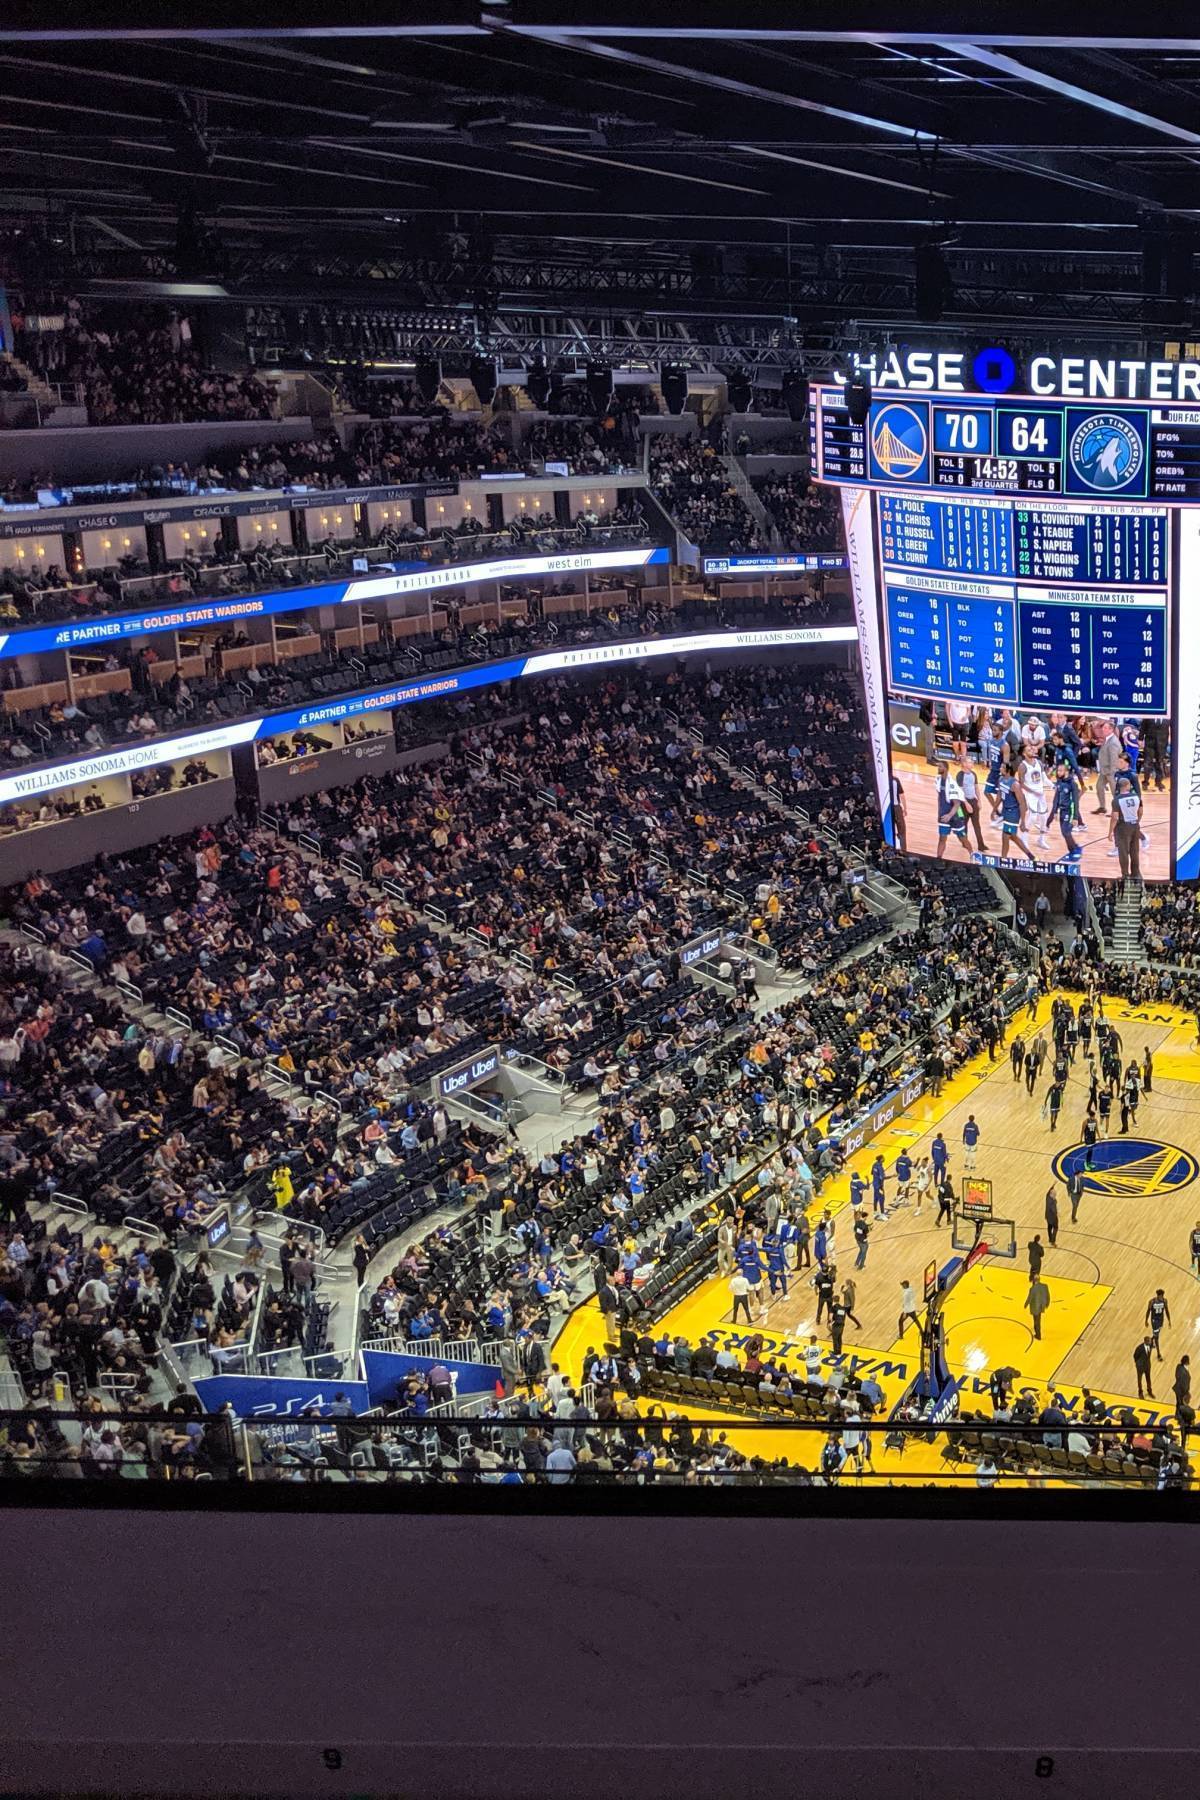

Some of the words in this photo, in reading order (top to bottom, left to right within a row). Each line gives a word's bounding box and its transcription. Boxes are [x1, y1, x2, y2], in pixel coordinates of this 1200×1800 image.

[945, 414, 978, 448] 70
[1012, 417, 1048, 452] 64
[1156, 433, 1180, 442] EFG%
[1075, 419, 1104, 461] MINNESOTA
[1109, 419, 1139, 478] TIMBERWOLVES
[1156, 450, 1174, 459] TO%
[939, 459, 954, 467] TOL
[957, 458, 964, 469] 5
[974, 458, 1018, 480] 14:52
[1028, 464, 1045, 472] TOL
[1048, 463, 1055, 474] 5
[1156, 467, 1184, 476] OREB%
[939, 475, 954, 483] FLS
[957, 474, 964, 485] 0
[971, 480, 983, 488] 3rd
[984, 480, 1019, 490] QUARTER
[1028, 480, 1043, 489] FLS
[1048, 480, 1055, 490] 0
[1166, 484, 1186, 492] RATE
[895, 500, 902, 510] J.
[902, 500, 925, 513] POOLE
[79, 519, 108, 528] CHASE
[895, 513, 904, 523] M.
[905, 514, 931, 527] CHRISS
[1018, 512, 1028, 523] 33
[1033, 513, 1041, 524] R.
[1042, 513, 1085, 526] COVINGTON
[896, 526, 903, 536] D.
[904, 527, 935, 540] RUSSELL
[1021, 525, 1027, 536] 0
[1033, 526, 1041, 537] J.
[1042, 527, 1074, 539] TEAGUE
[897, 538, 904, 549] D.
[904, 539, 928, 551] GREEN
[1019, 538, 1028, 549] 13
[1033, 539, 1041, 550] S.
[1043, 540, 1073, 551] NAPIER
[547, 557, 572, 569] west
[574, 556, 592, 568] elm
[897, 550, 904, 561] S.
[905, 551, 928, 565] CURRY
[1019, 551, 1030, 562] 22
[1034, 552, 1042, 563] A.
[1043, 552, 1079, 565] WIGGINS
[1019, 564, 1030, 575] 32
[1034, 564, 1042, 576] K.
[1044, 565, 1074, 578] TOWNS
[906, 576, 930, 588] GOLDEN
[930, 580, 949, 590] STATE
[950, 582, 968, 593] TEAM
[969, 584, 990, 595] STATS
[1048, 591, 1090, 601] MINNESOTA
[1091, 593, 1111, 602] TEAM
[1112, 594, 1135, 604] STATS
[73, 624, 120, 640] PARTNER
[143, 613, 183, 628] GOLDEN
[186, 609, 213, 622] STATE
[214, 601, 264, 618] WARRIORS
[736, 632, 782, 644] WILLIAMS
[785, 631, 822, 641] SONOMA
[299, 714, 308, 723] E
[309, 705, 346, 722] PARTNER
[364, 692, 395, 709] GOLDEN
[397, 687, 419, 701] STATE
[420, 679, 458, 695] WARRIORS
[891, 723, 921, 746] er
[14, 769, 77, 793] WILLIAMS
[78, 757, 126, 777] SONOMA
[128, 749, 159, 765] HOME
[684, 948, 700, 963] Uber
[703, 938, 719, 953] Uber
[1118, 1010, 1173, 1024] SAN
[444, 1072, 468, 1093] Uber
[472, 1058, 495, 1078] Uber
[873, 1105, 895, 1132] Uber
[902, 1083, 923, 1107] Uber
[211, 1221, 226, 1243] Uber
[706, 1329, 908, 1380] WARIORS
[324, 1749, 342, 1770] 9
[1035, 1757, 1054, 1778] 8
